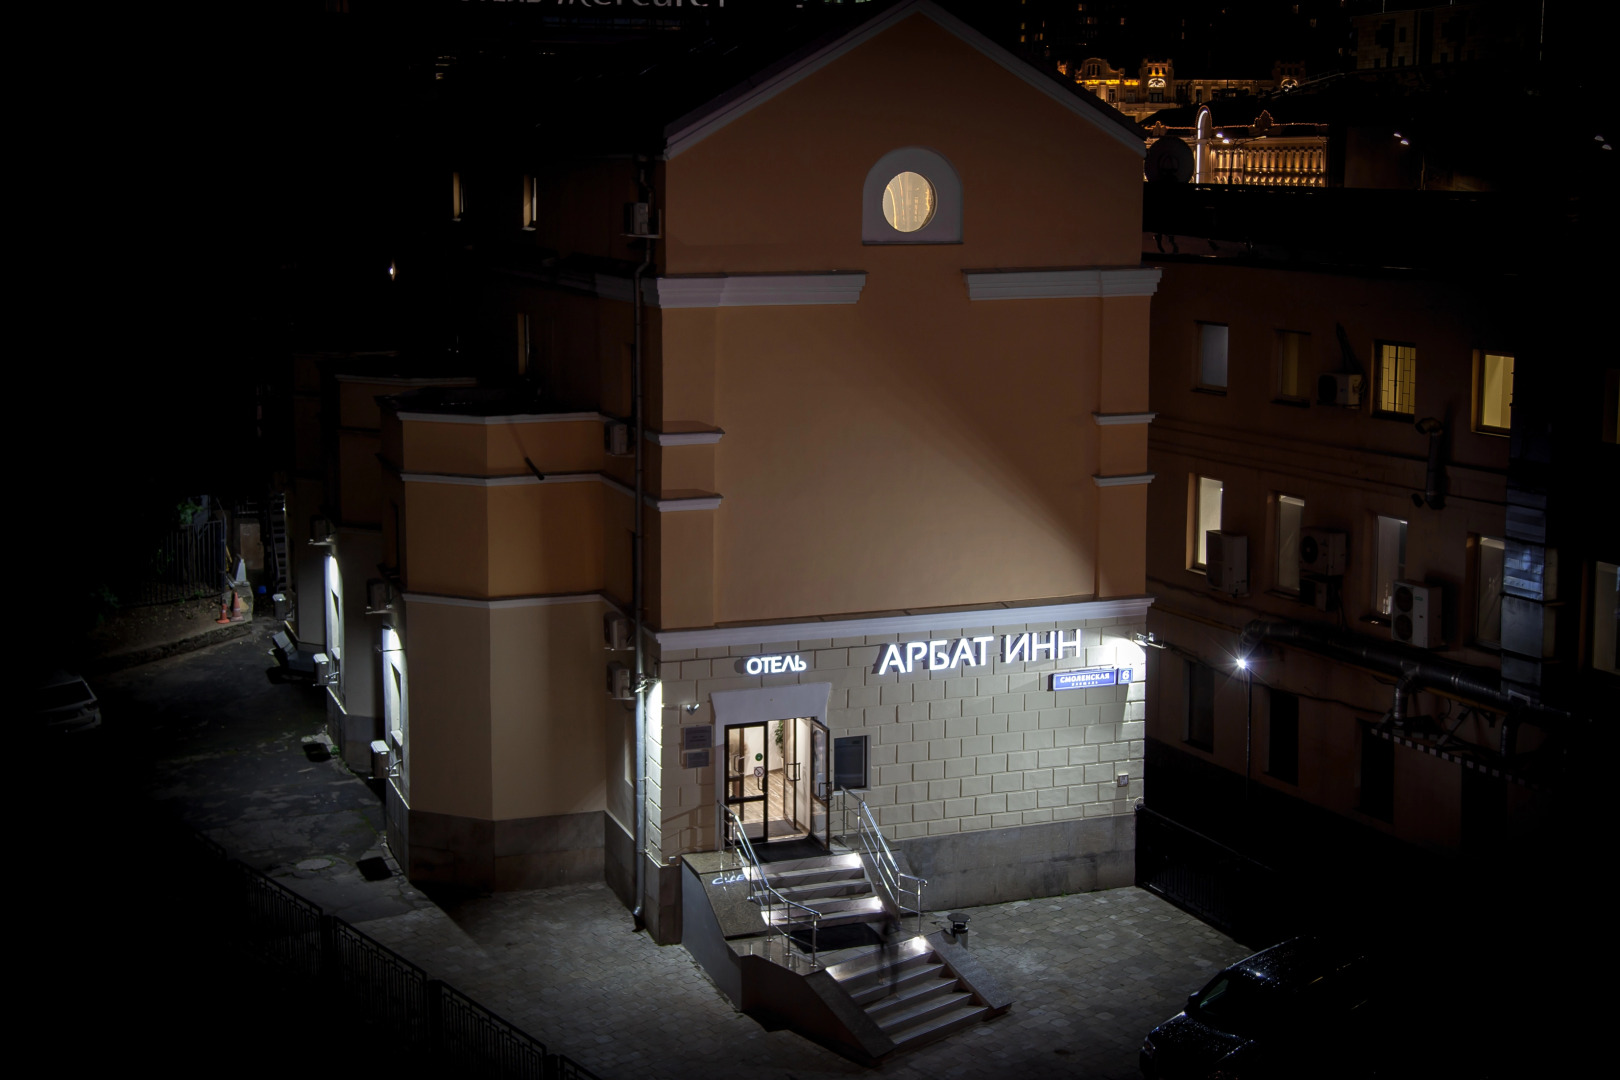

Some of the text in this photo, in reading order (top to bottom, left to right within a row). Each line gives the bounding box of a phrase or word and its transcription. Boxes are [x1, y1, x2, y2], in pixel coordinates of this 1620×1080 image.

[879, 628, 1081, 675] АРБАТ ИНН
[746, 655, 807, 675] ОТЕЛЬ
[1060, 673, 1110, 684] СМОЛЕНСКАЯ
[1122, 670, 1130, 680] 6
